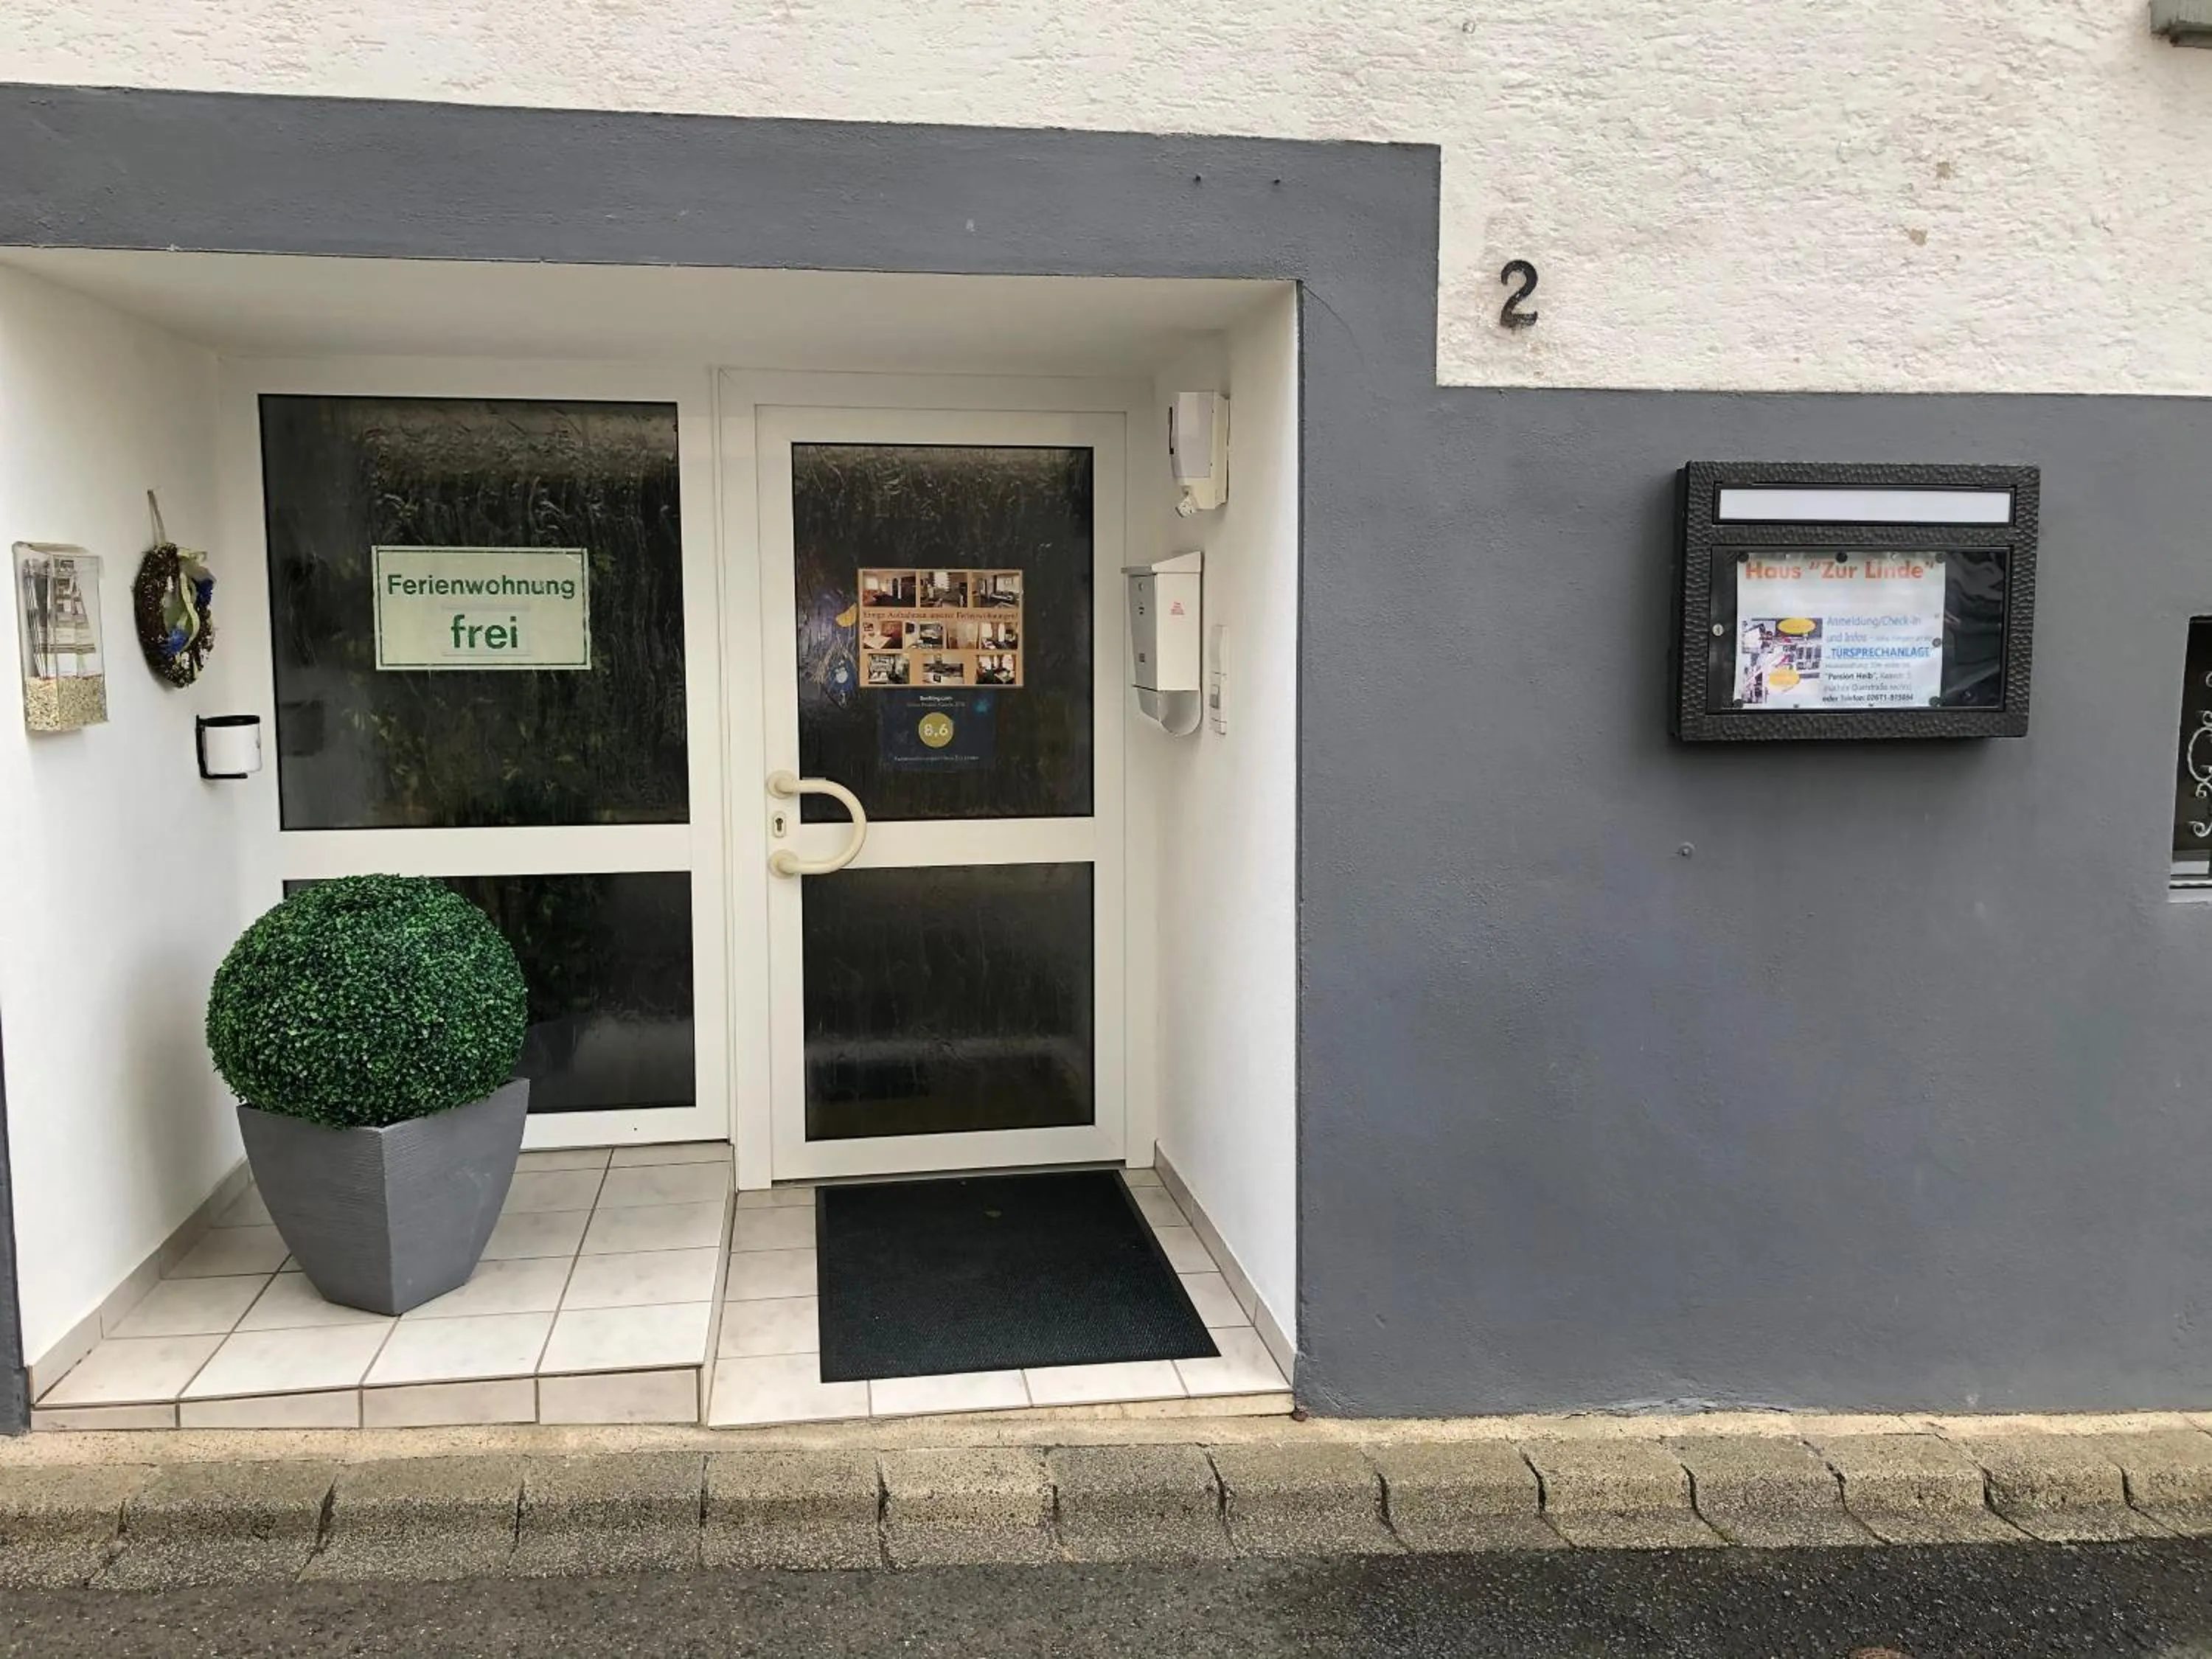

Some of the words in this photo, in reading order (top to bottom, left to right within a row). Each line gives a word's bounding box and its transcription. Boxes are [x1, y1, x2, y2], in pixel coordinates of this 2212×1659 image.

[1500, 260, 1538, 329] 2
[1745, 560, 1802, 579] Haus
[387, 574, 575, 599] Ferienwohnung
[451, 614, 518, 649] frei
